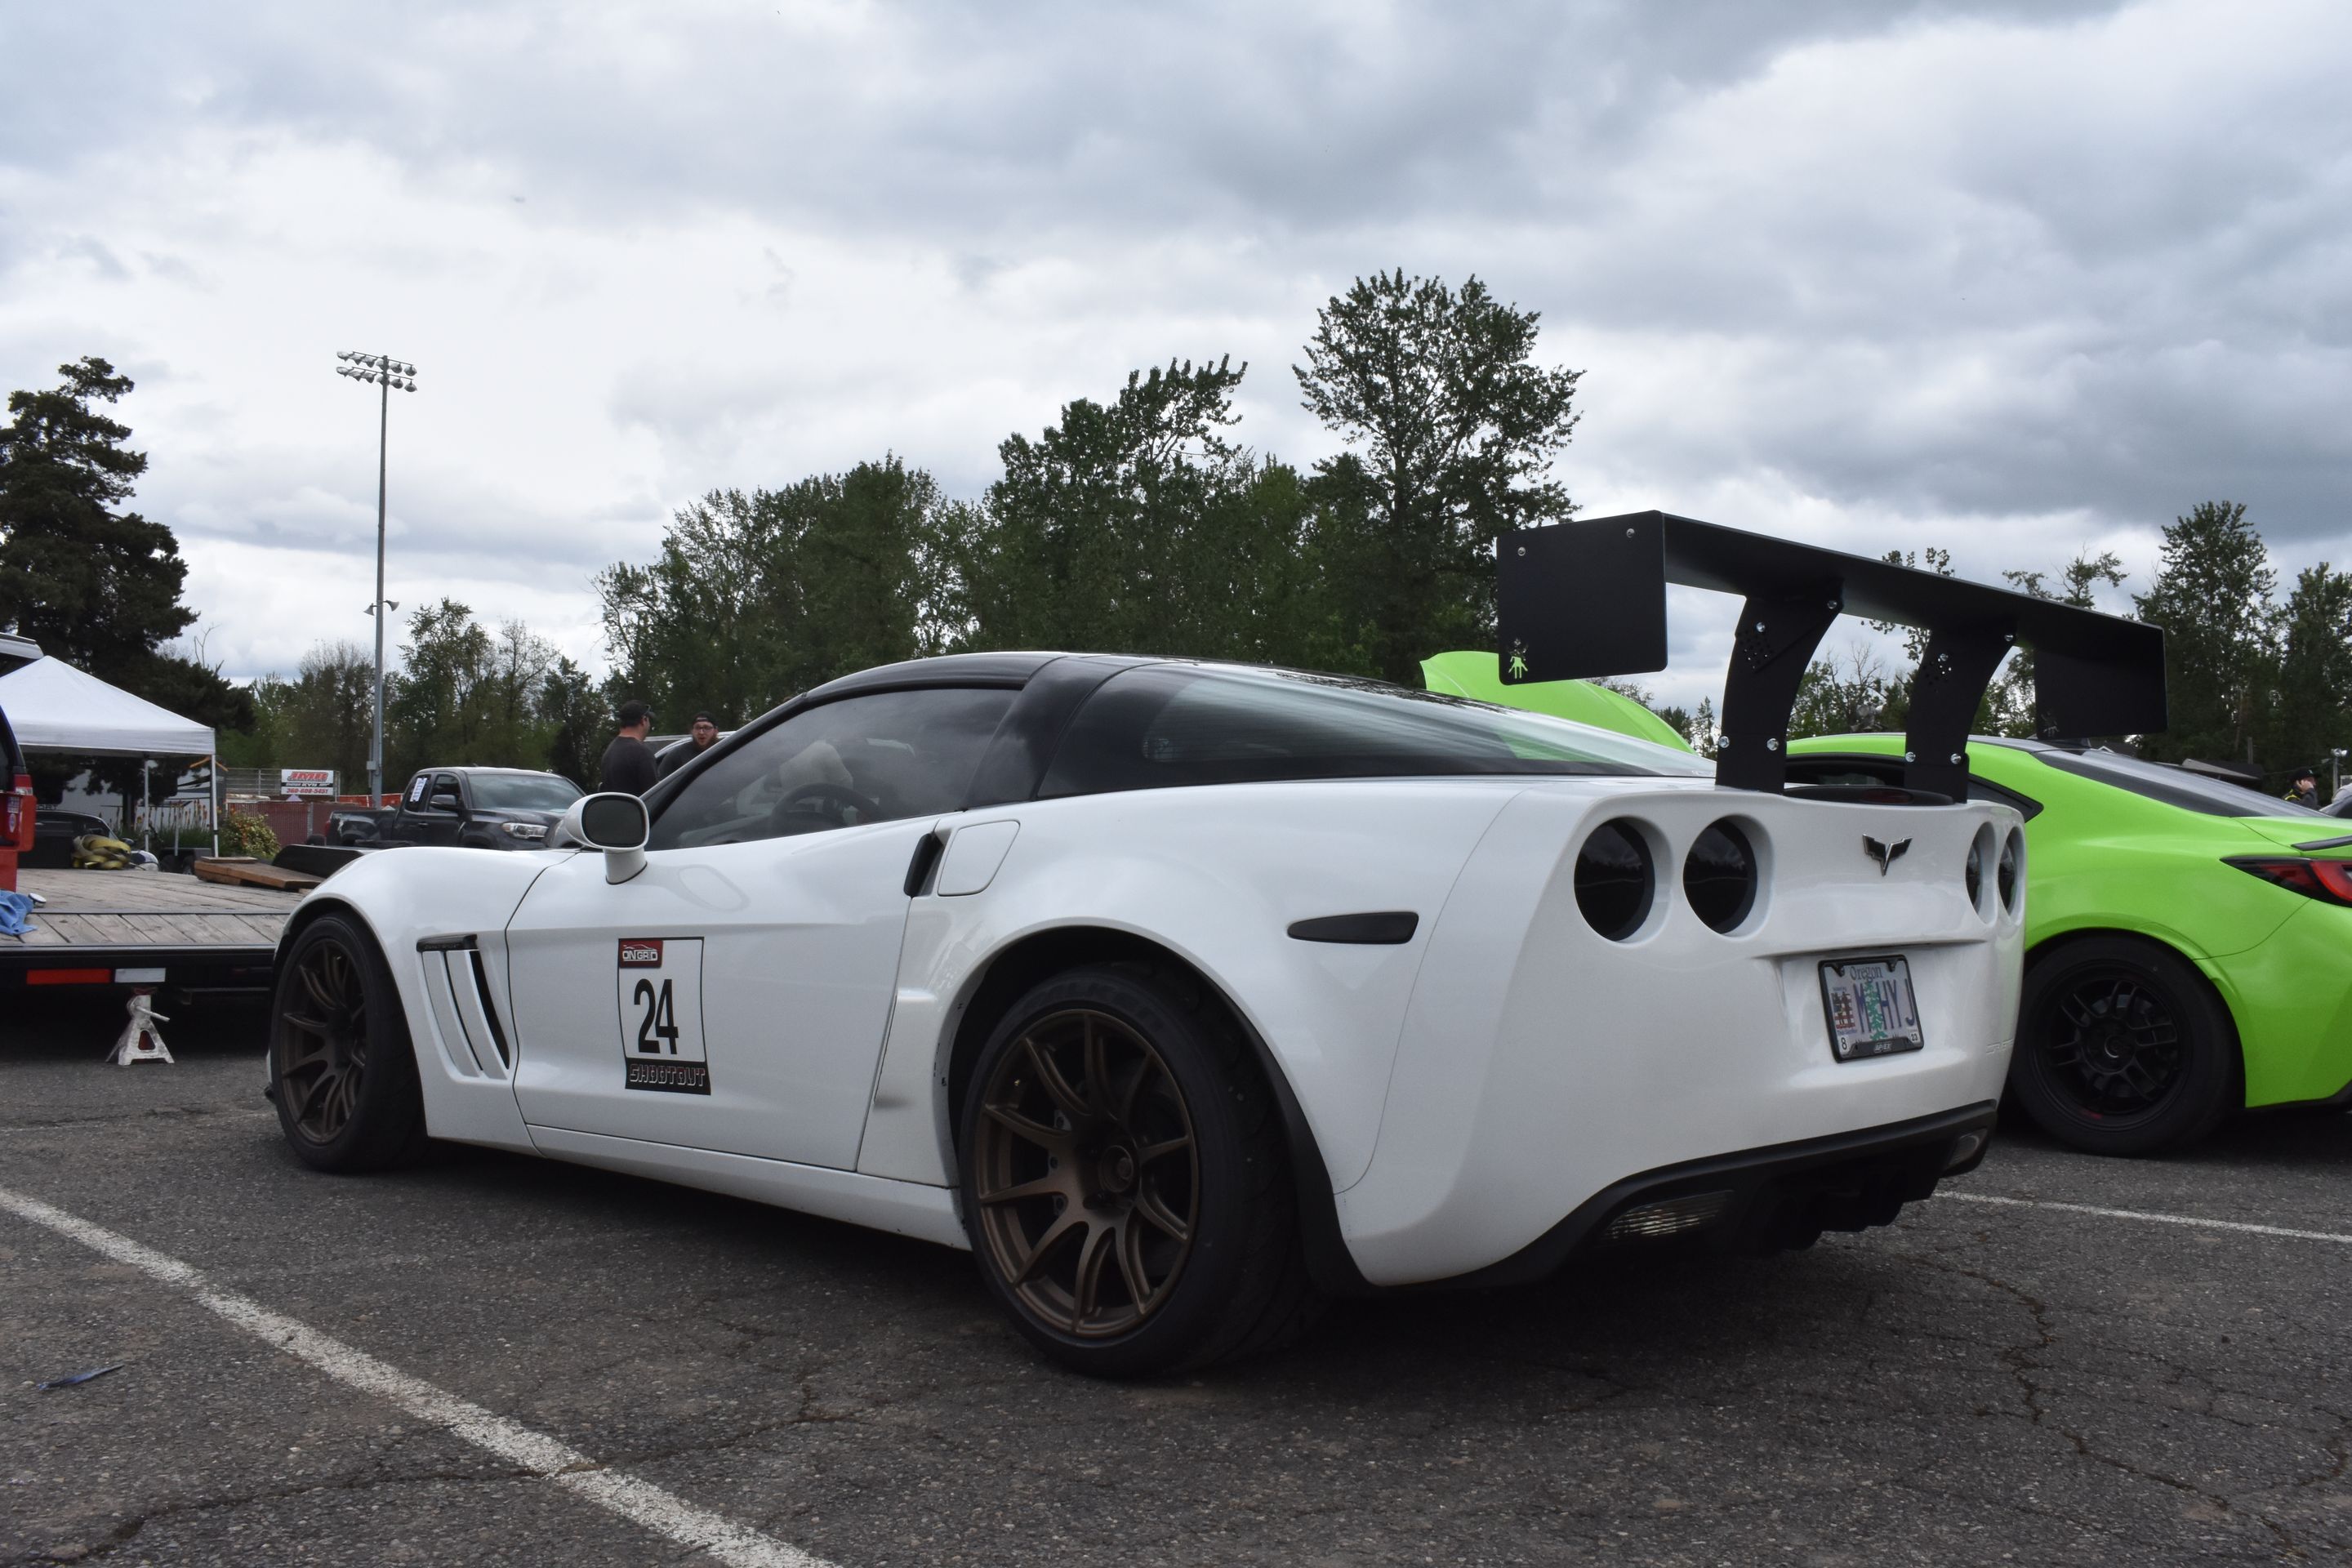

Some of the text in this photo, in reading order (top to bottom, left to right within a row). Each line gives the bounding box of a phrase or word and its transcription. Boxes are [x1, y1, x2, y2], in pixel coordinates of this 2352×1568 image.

[1850, 966, 1883, 982] Oregon
[634, 978, 679, 1054] 24
[1841, 1036, 1847, 1050] 8
[630, 1064, 706, 1087] SHOOTOUT
